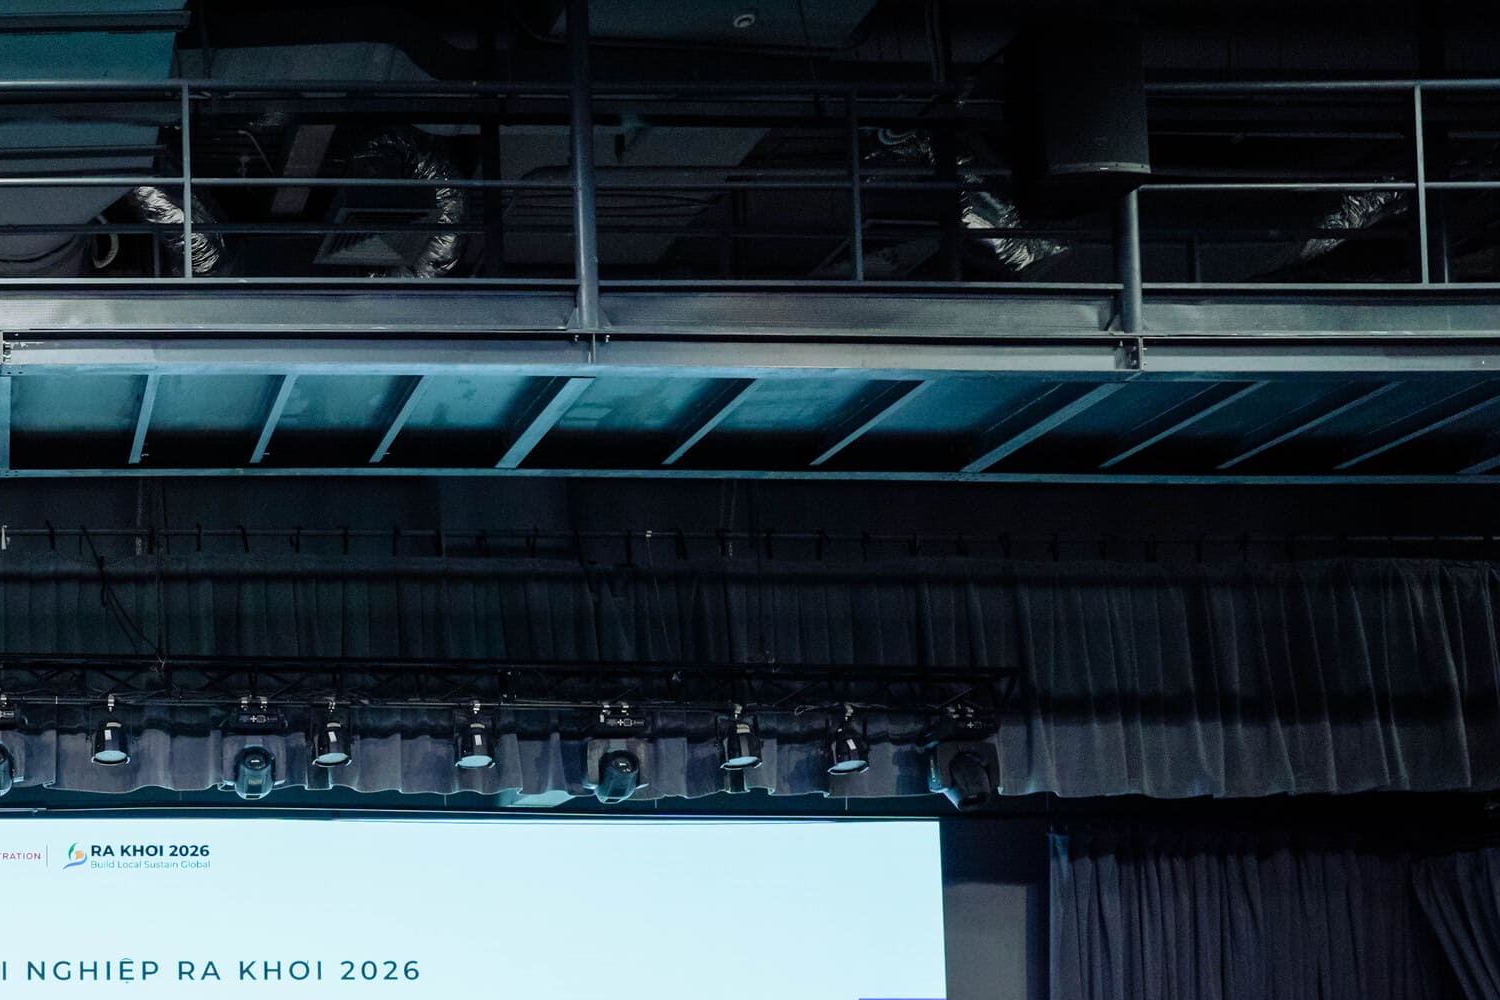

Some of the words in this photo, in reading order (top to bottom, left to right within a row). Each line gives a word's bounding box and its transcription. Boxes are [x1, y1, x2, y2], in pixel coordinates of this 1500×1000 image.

[91, 845, 115, 857] RA
[169, 845, 210, 857] 2026
[91, 860, 115, 869] Build
[118, 860, 142, 869] Local
[144, 860, 179, 869] Sustain
[181, 860, 211, 869] Global
[27, 957, 159, 984] NGHIỆP
[178, 960, 222, 981] RA
[239, 959, 322, 981] KHƠI
[340, 960, 420, 981] 2026
